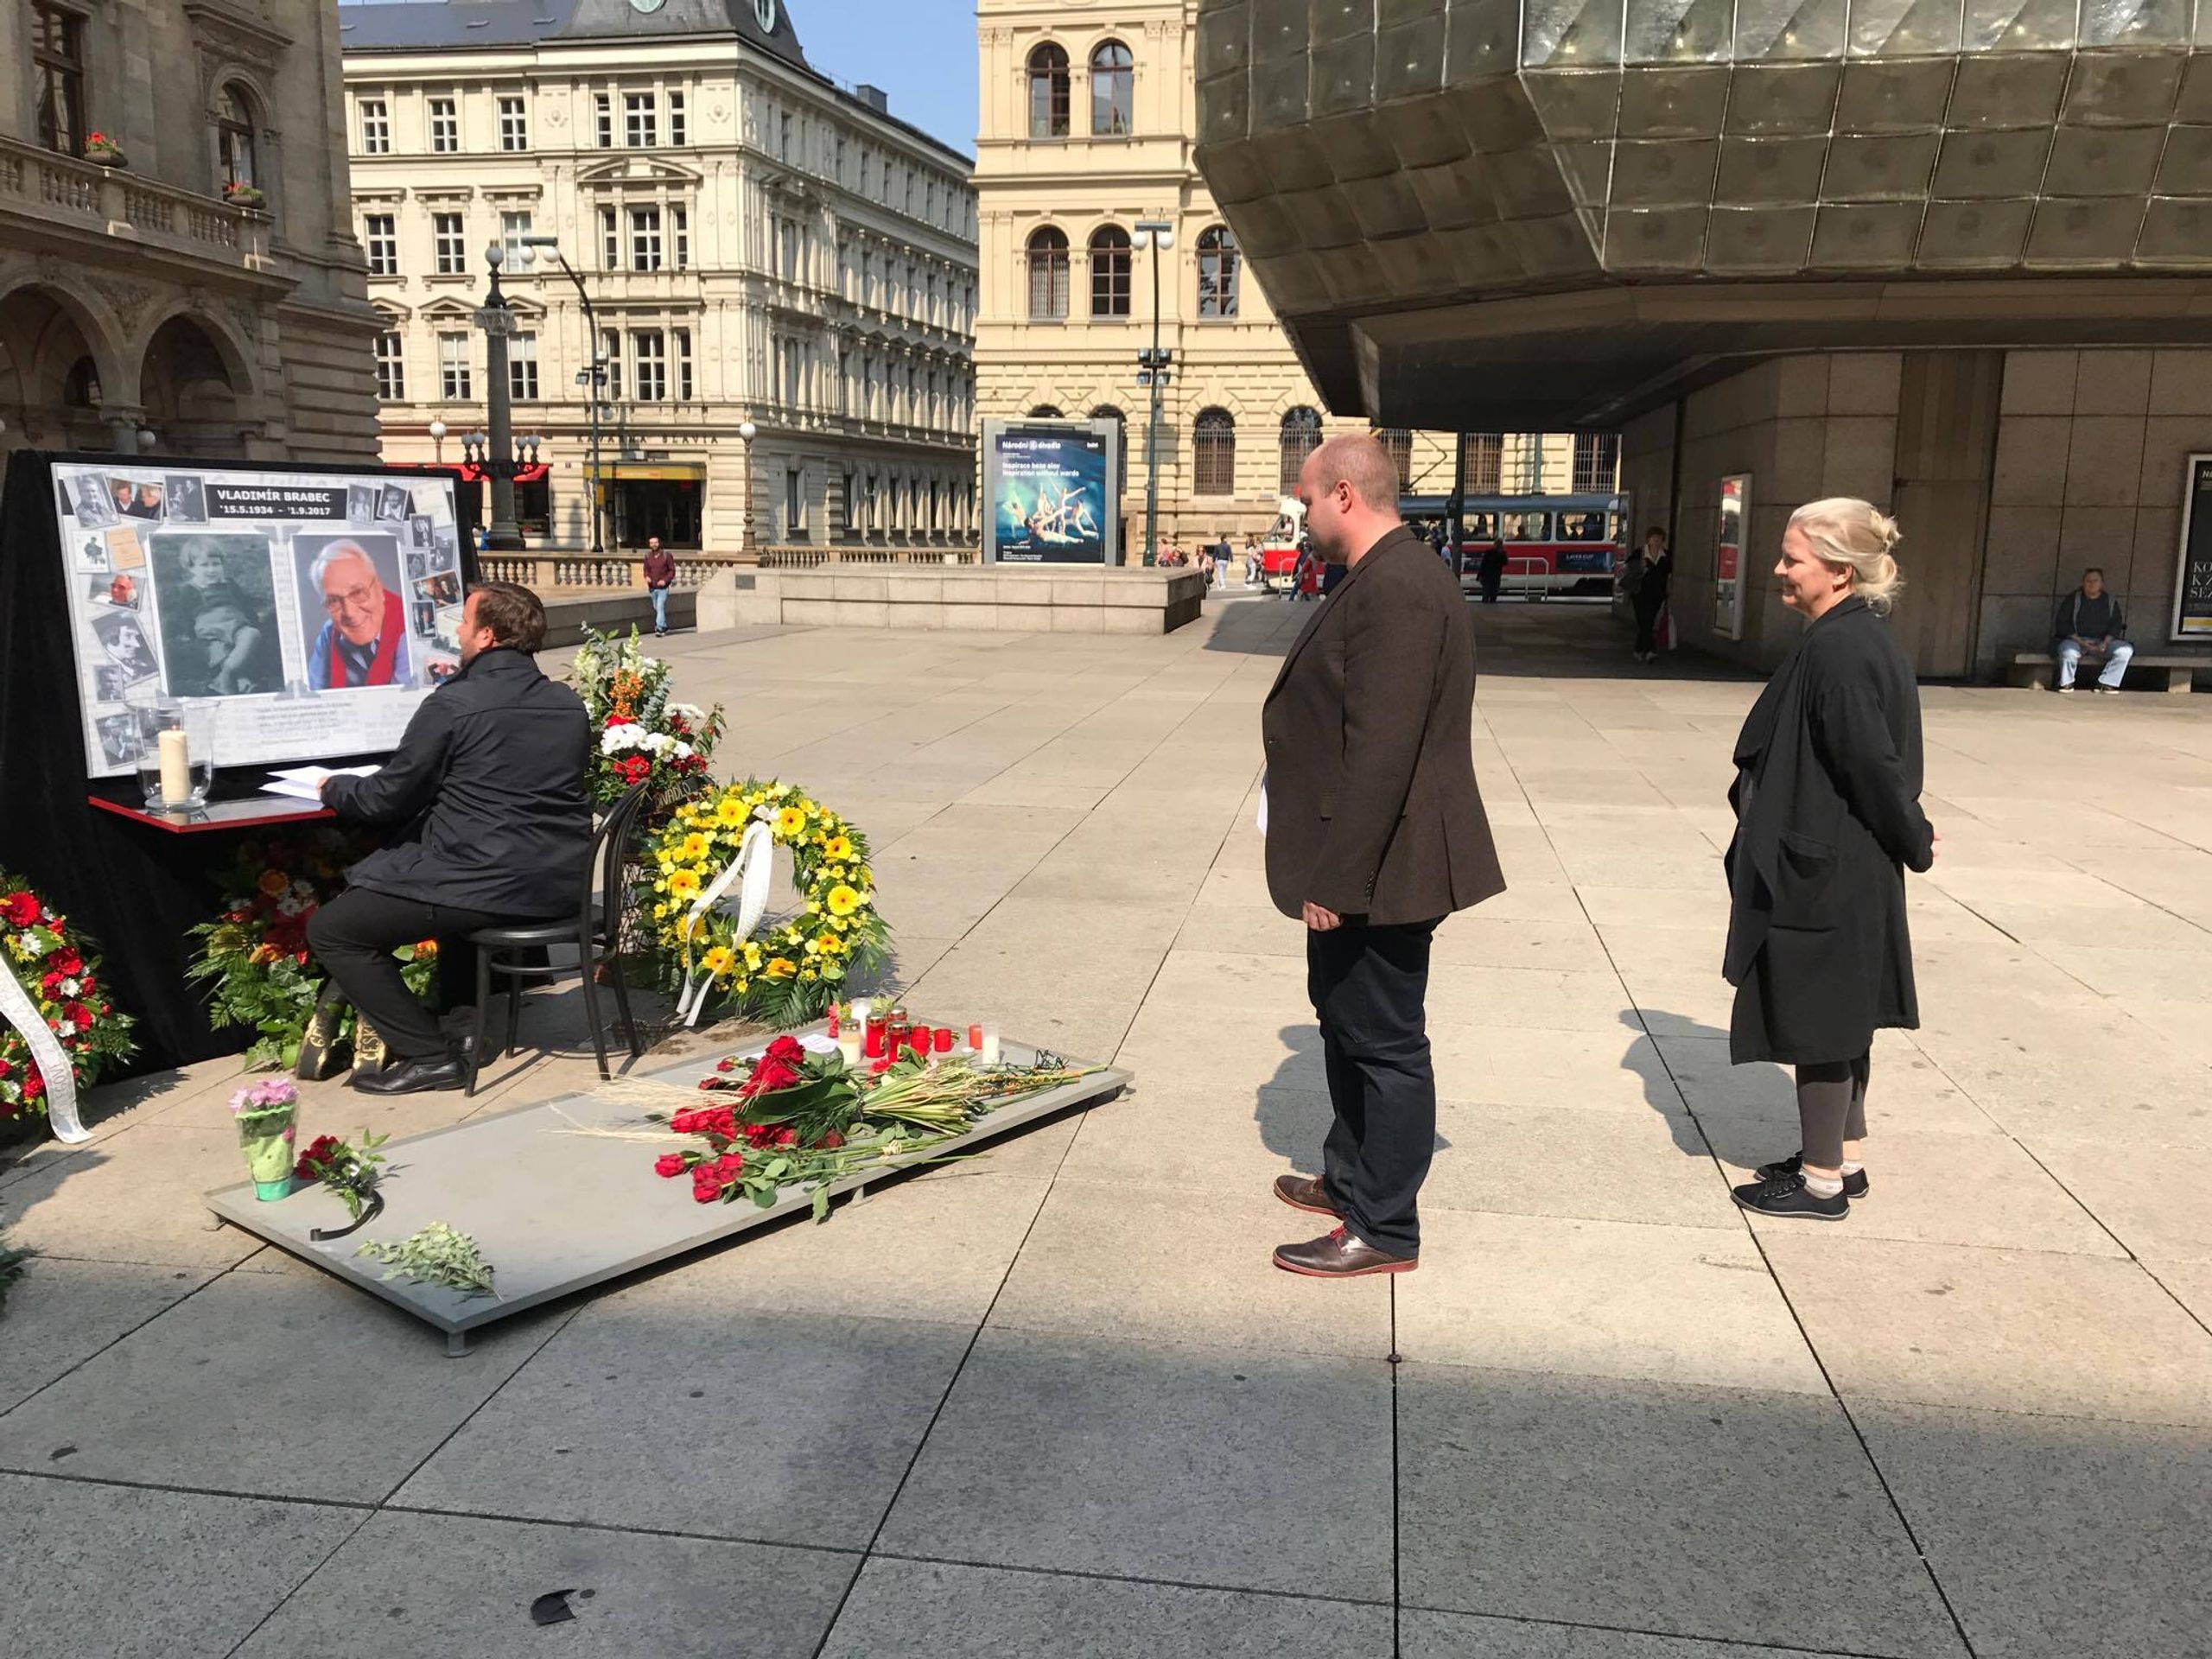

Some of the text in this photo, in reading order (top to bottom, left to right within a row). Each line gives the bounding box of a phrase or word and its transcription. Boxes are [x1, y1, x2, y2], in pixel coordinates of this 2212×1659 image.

[663, 434, 719, 444] SLAVIA
[1039, 441, 1062, 449] divadlo
[217, 488, 330, 502] VLADIMÍR BRABEC
